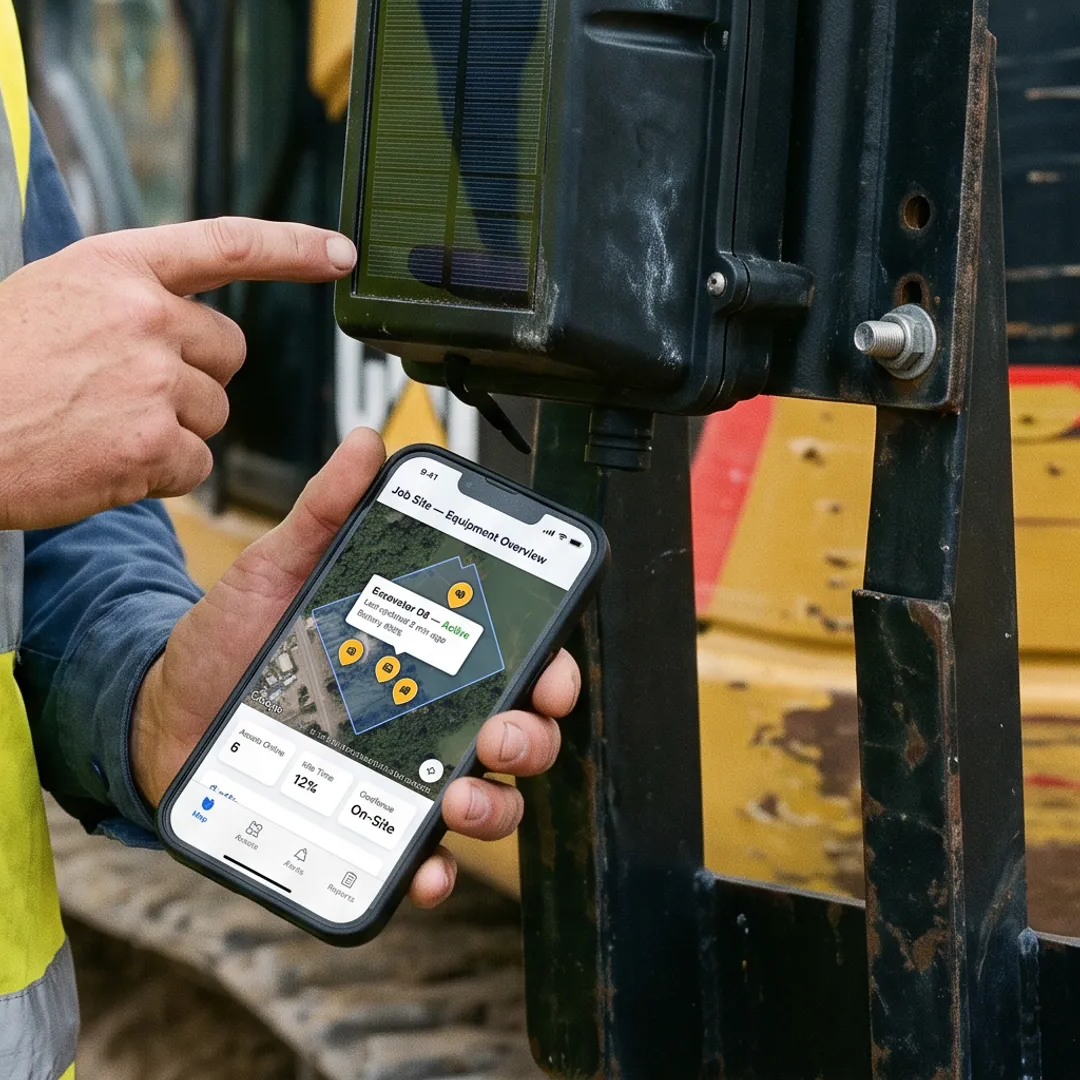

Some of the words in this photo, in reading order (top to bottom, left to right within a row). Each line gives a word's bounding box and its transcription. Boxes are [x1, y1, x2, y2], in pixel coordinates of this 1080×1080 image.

[391, 486, 411, 500] Job
[412, 494, 432, 511] Site
[445, 510, 500, 543] Equipment
[500, 536, 548, 565] Overview
[230, 741, 241, 753] 6
[294, 774, 318, 794] 12%
[350, 804, 396, 835] On-Site
